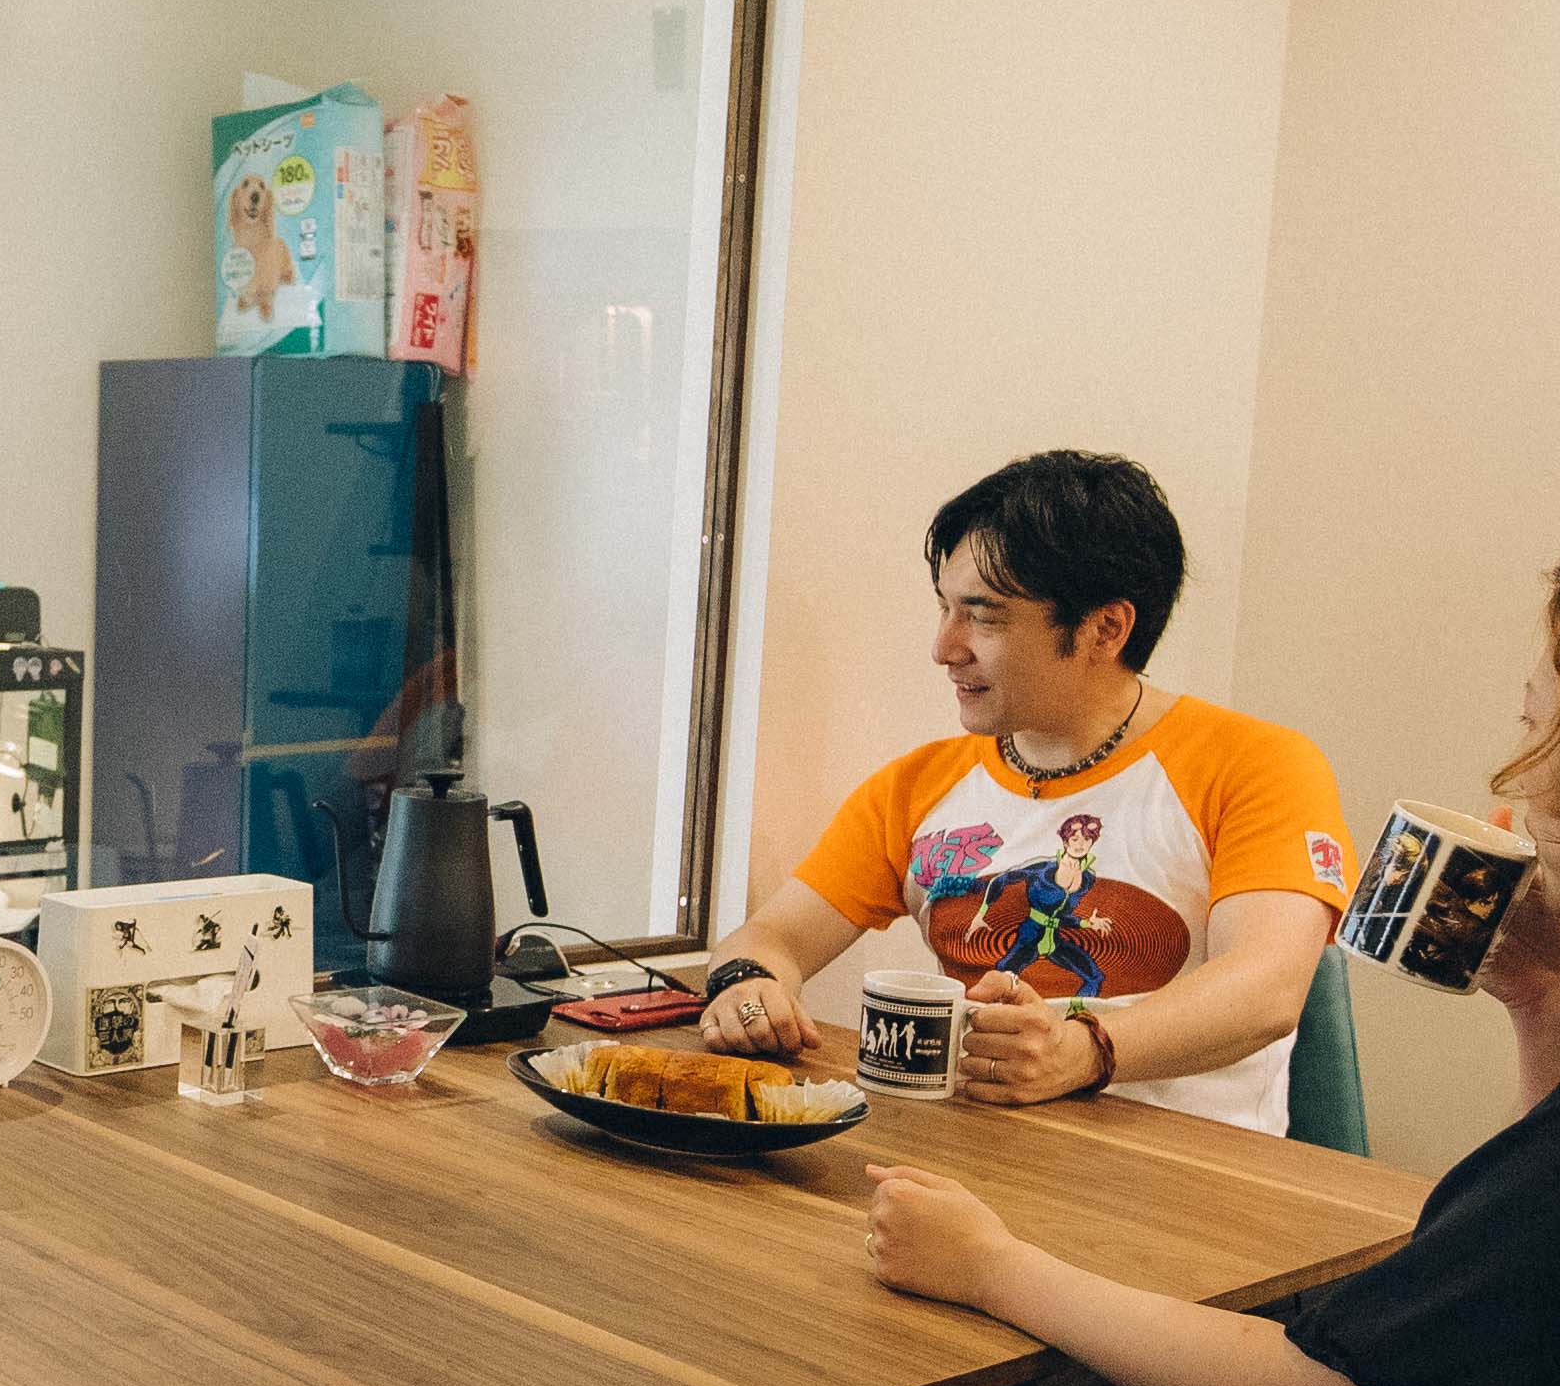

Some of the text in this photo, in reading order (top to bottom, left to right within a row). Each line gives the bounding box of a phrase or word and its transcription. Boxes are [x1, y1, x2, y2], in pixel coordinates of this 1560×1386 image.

[11, 966, 24, 979] 30
[20, 984, 34, 997] 40
[20, 1006, 34, 1020] 50
